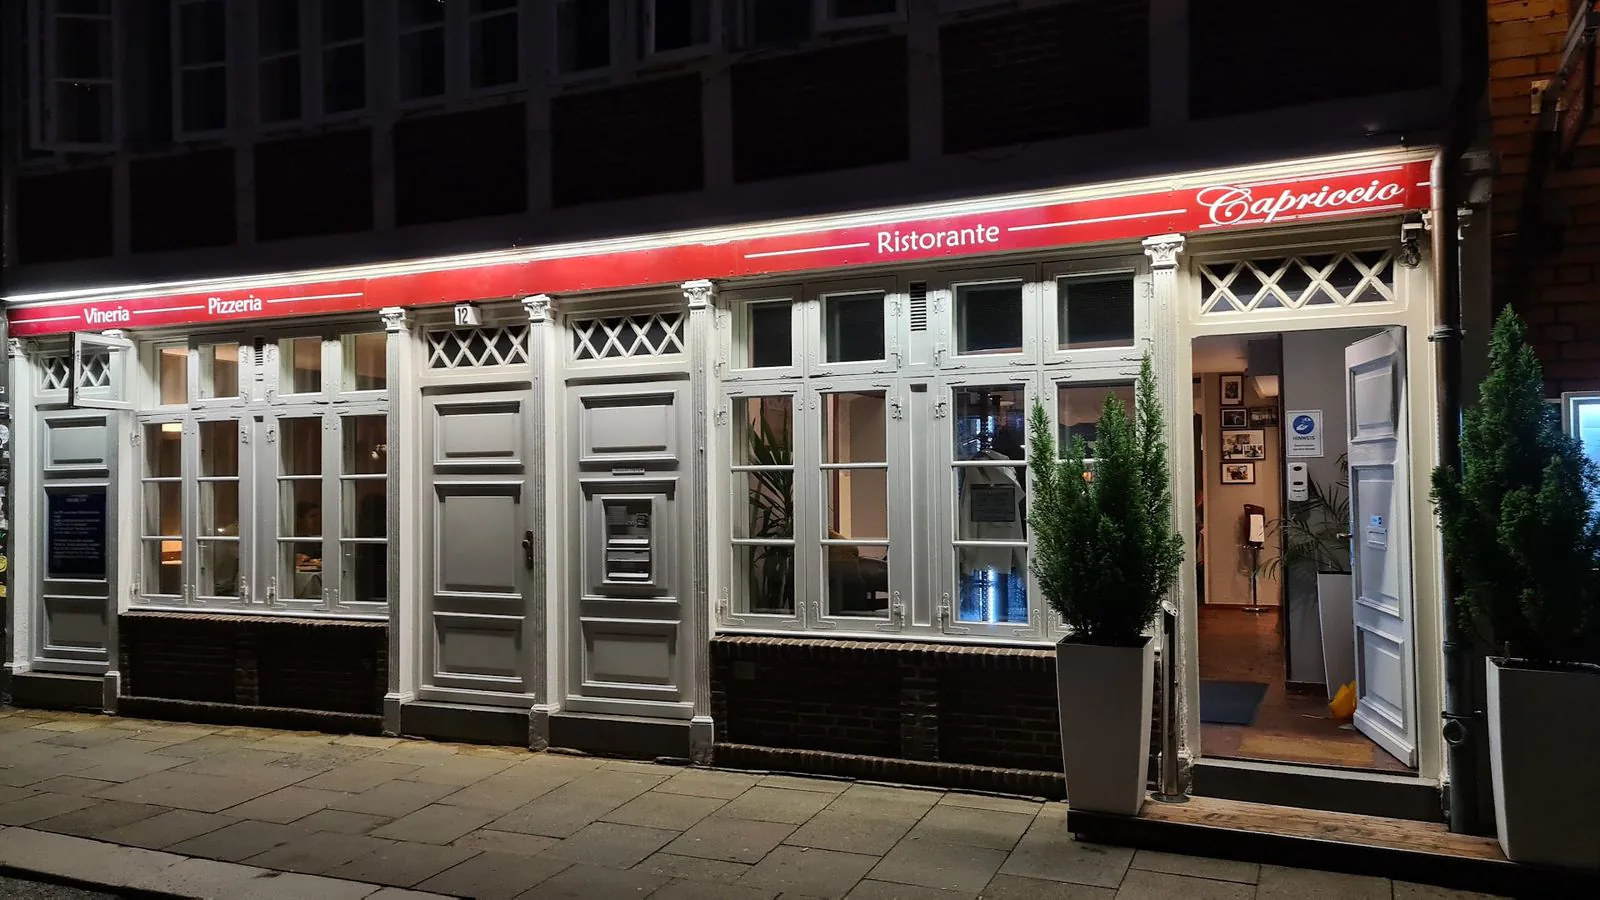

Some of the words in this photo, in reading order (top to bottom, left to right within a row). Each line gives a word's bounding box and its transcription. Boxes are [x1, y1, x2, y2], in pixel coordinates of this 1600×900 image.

[1196, 180, 1405, 225] Capriccio
[877, 224, 1000, 254] Ristorante
[83, 306, 130, 324] Vineria
[208, 294, 262, 315] Pizzeria
[456, 307, 469, 325] 12
